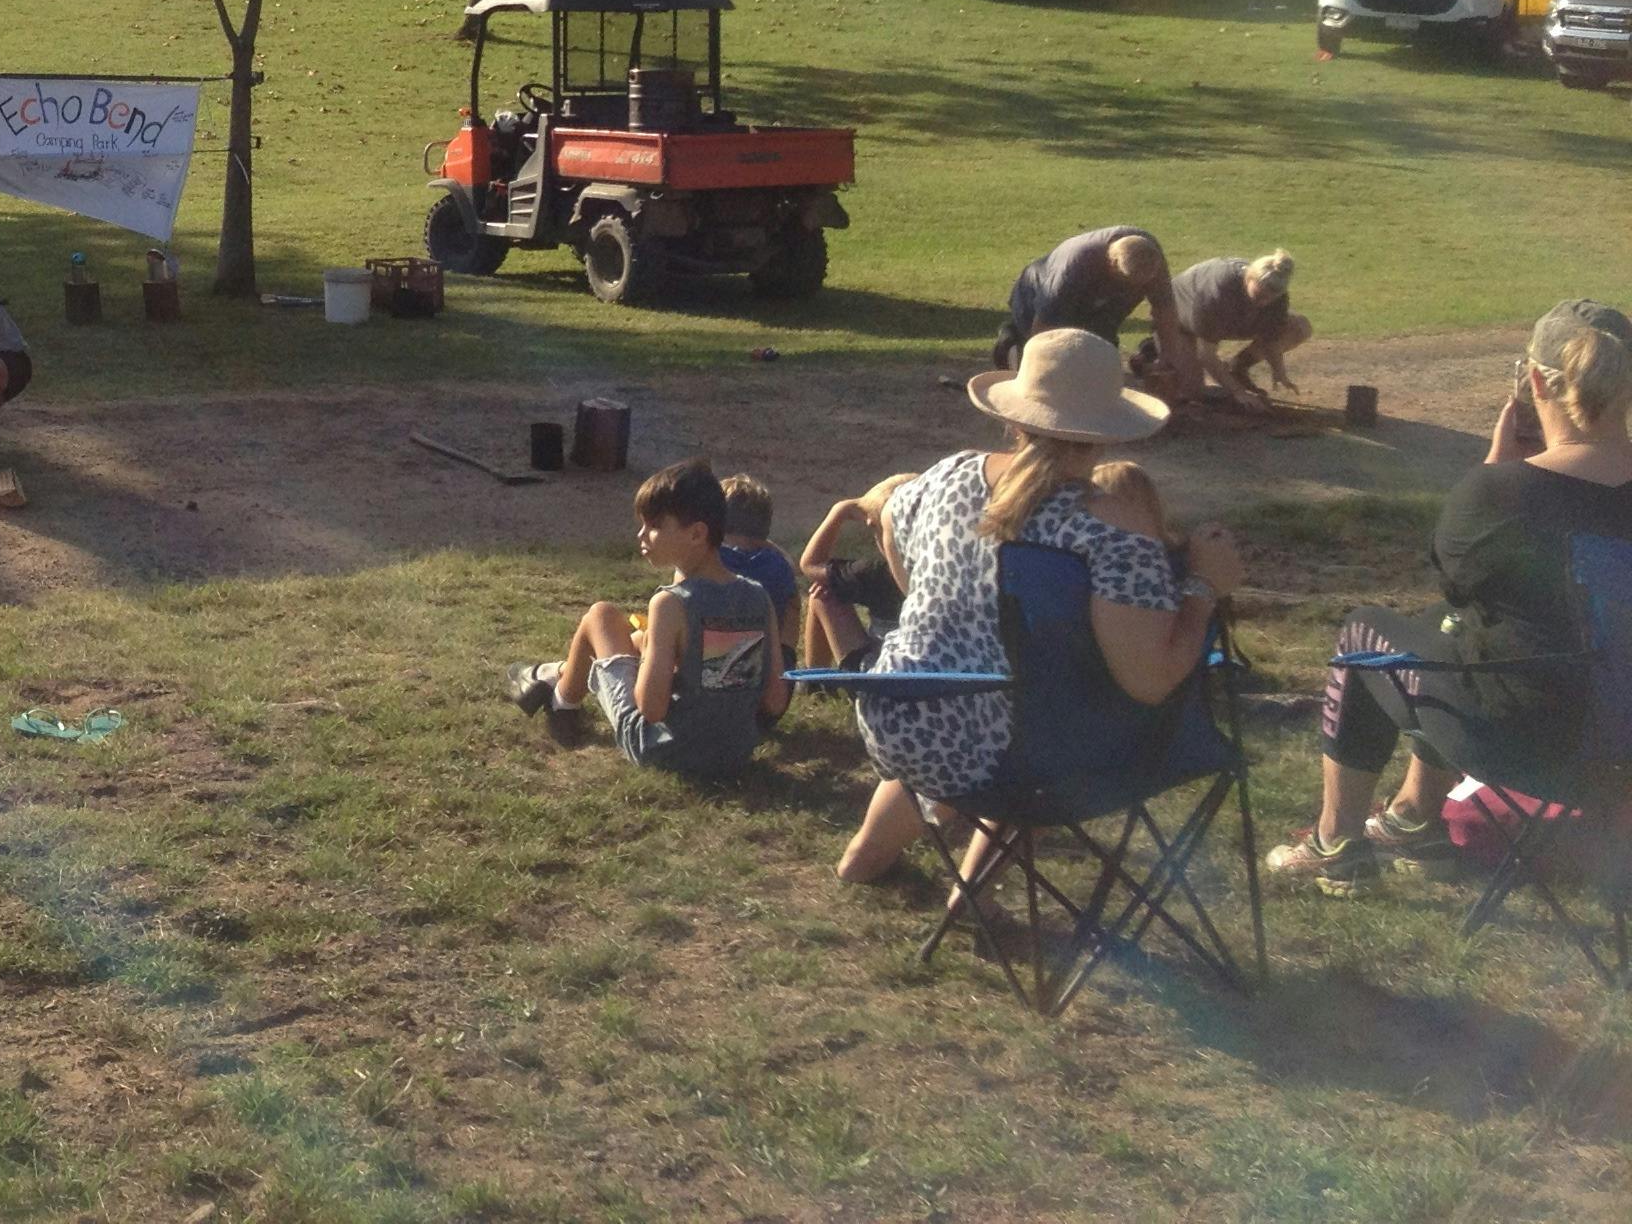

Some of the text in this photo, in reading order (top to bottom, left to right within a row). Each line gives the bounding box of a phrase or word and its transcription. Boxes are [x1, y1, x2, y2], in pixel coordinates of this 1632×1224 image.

[89, 88, 179, 147] Bend
[36, 132, 83, 155] Camping
[92, 133, 119, 150] Park
